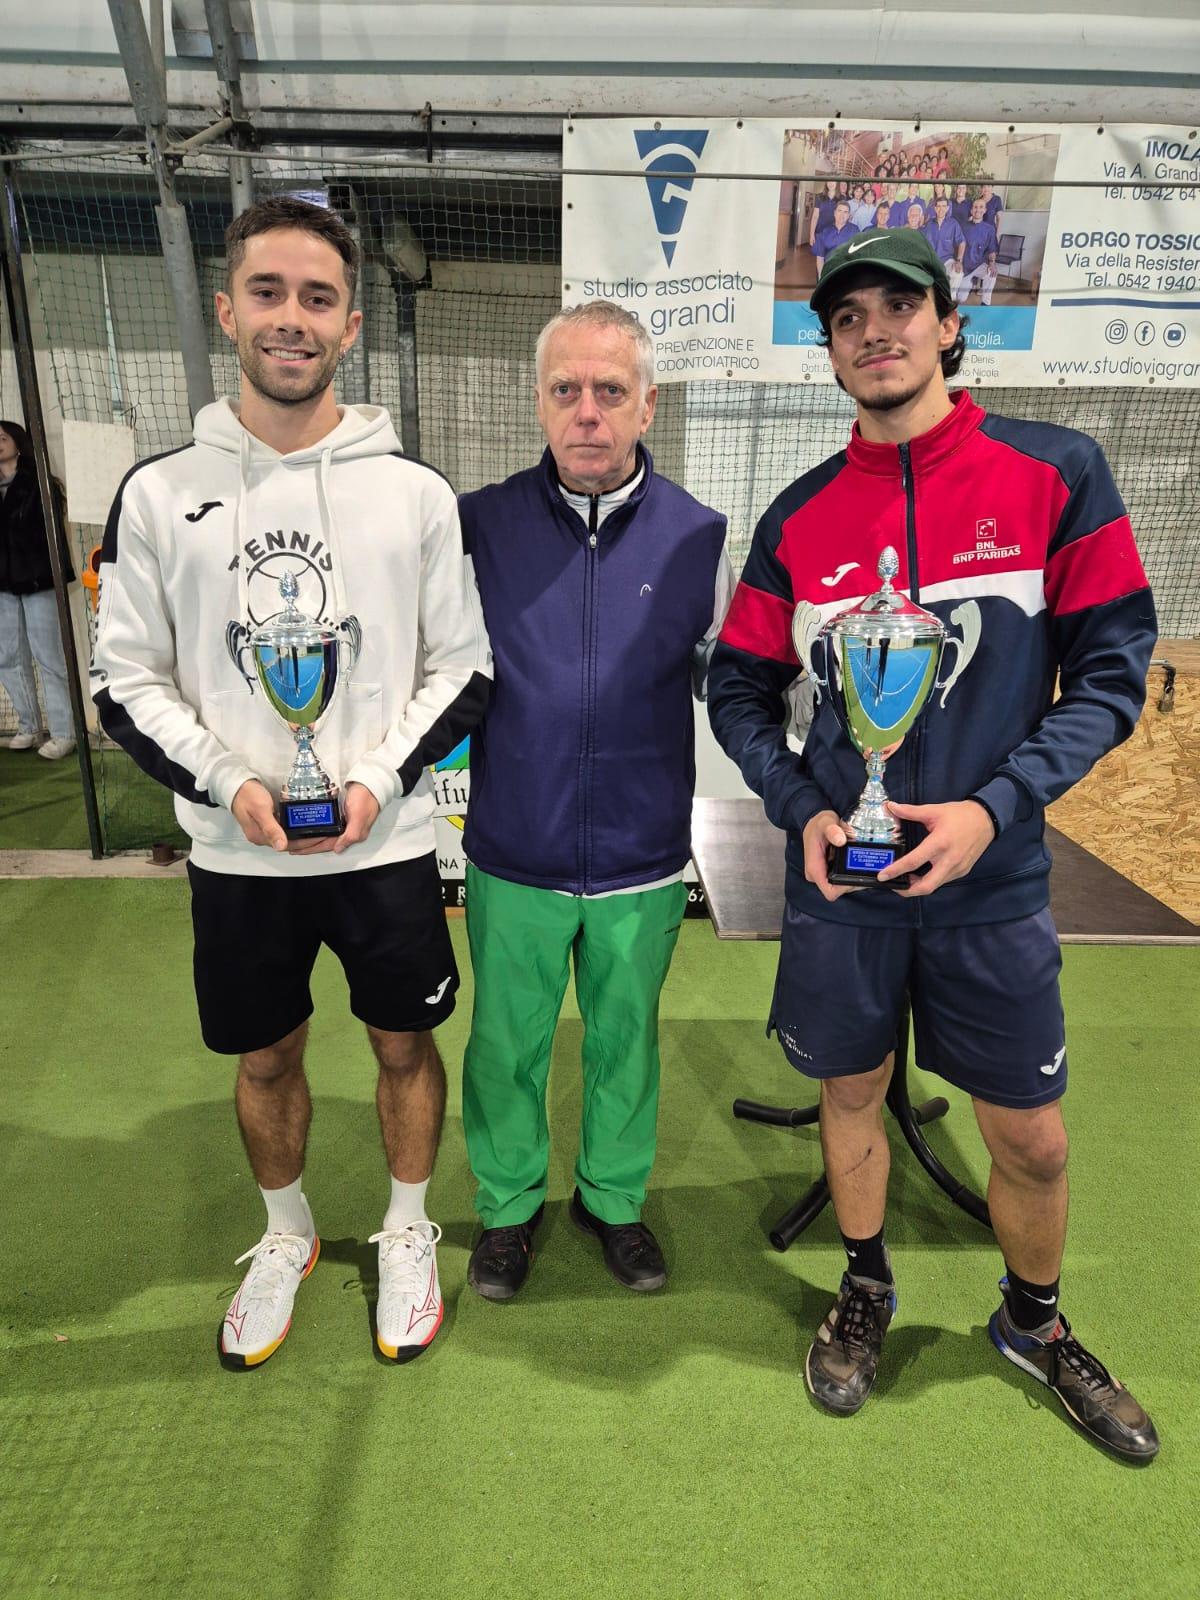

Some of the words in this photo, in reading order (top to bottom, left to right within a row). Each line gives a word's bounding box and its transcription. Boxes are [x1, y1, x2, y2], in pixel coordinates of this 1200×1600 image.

[1103, 162, 1126, 178] Via
[1104, 186, 1126, 200] Tel.
[1132, 186, 1174, 201] 0542
[1179, 187, 1200, 201] 64
[1060, 231, 1130, 248] BORGO
[1065, 253, 1090, 268] Via
[1096, 252, 1131, 268] della
[583, 277, 648, 298] studio
[655, 269, 753, 297] associato
[1085, 271, 1112, 287] Tel.
[1117, 273, 1151, 290] 0542
[1156, 275, 1200, 291] 1940
[650, 297, 735, 336] grandi
[656, 337, 743, 355] PREVENZIONE
[656, 355, 759, 372] ODONTOIATRICO
[228, 529, 333, 572] TENNIS
[976, 540, 998, 551] BNL
[952, 553, 975, 565] BNP
[976, 547, 1022, 561] PARIBAS
